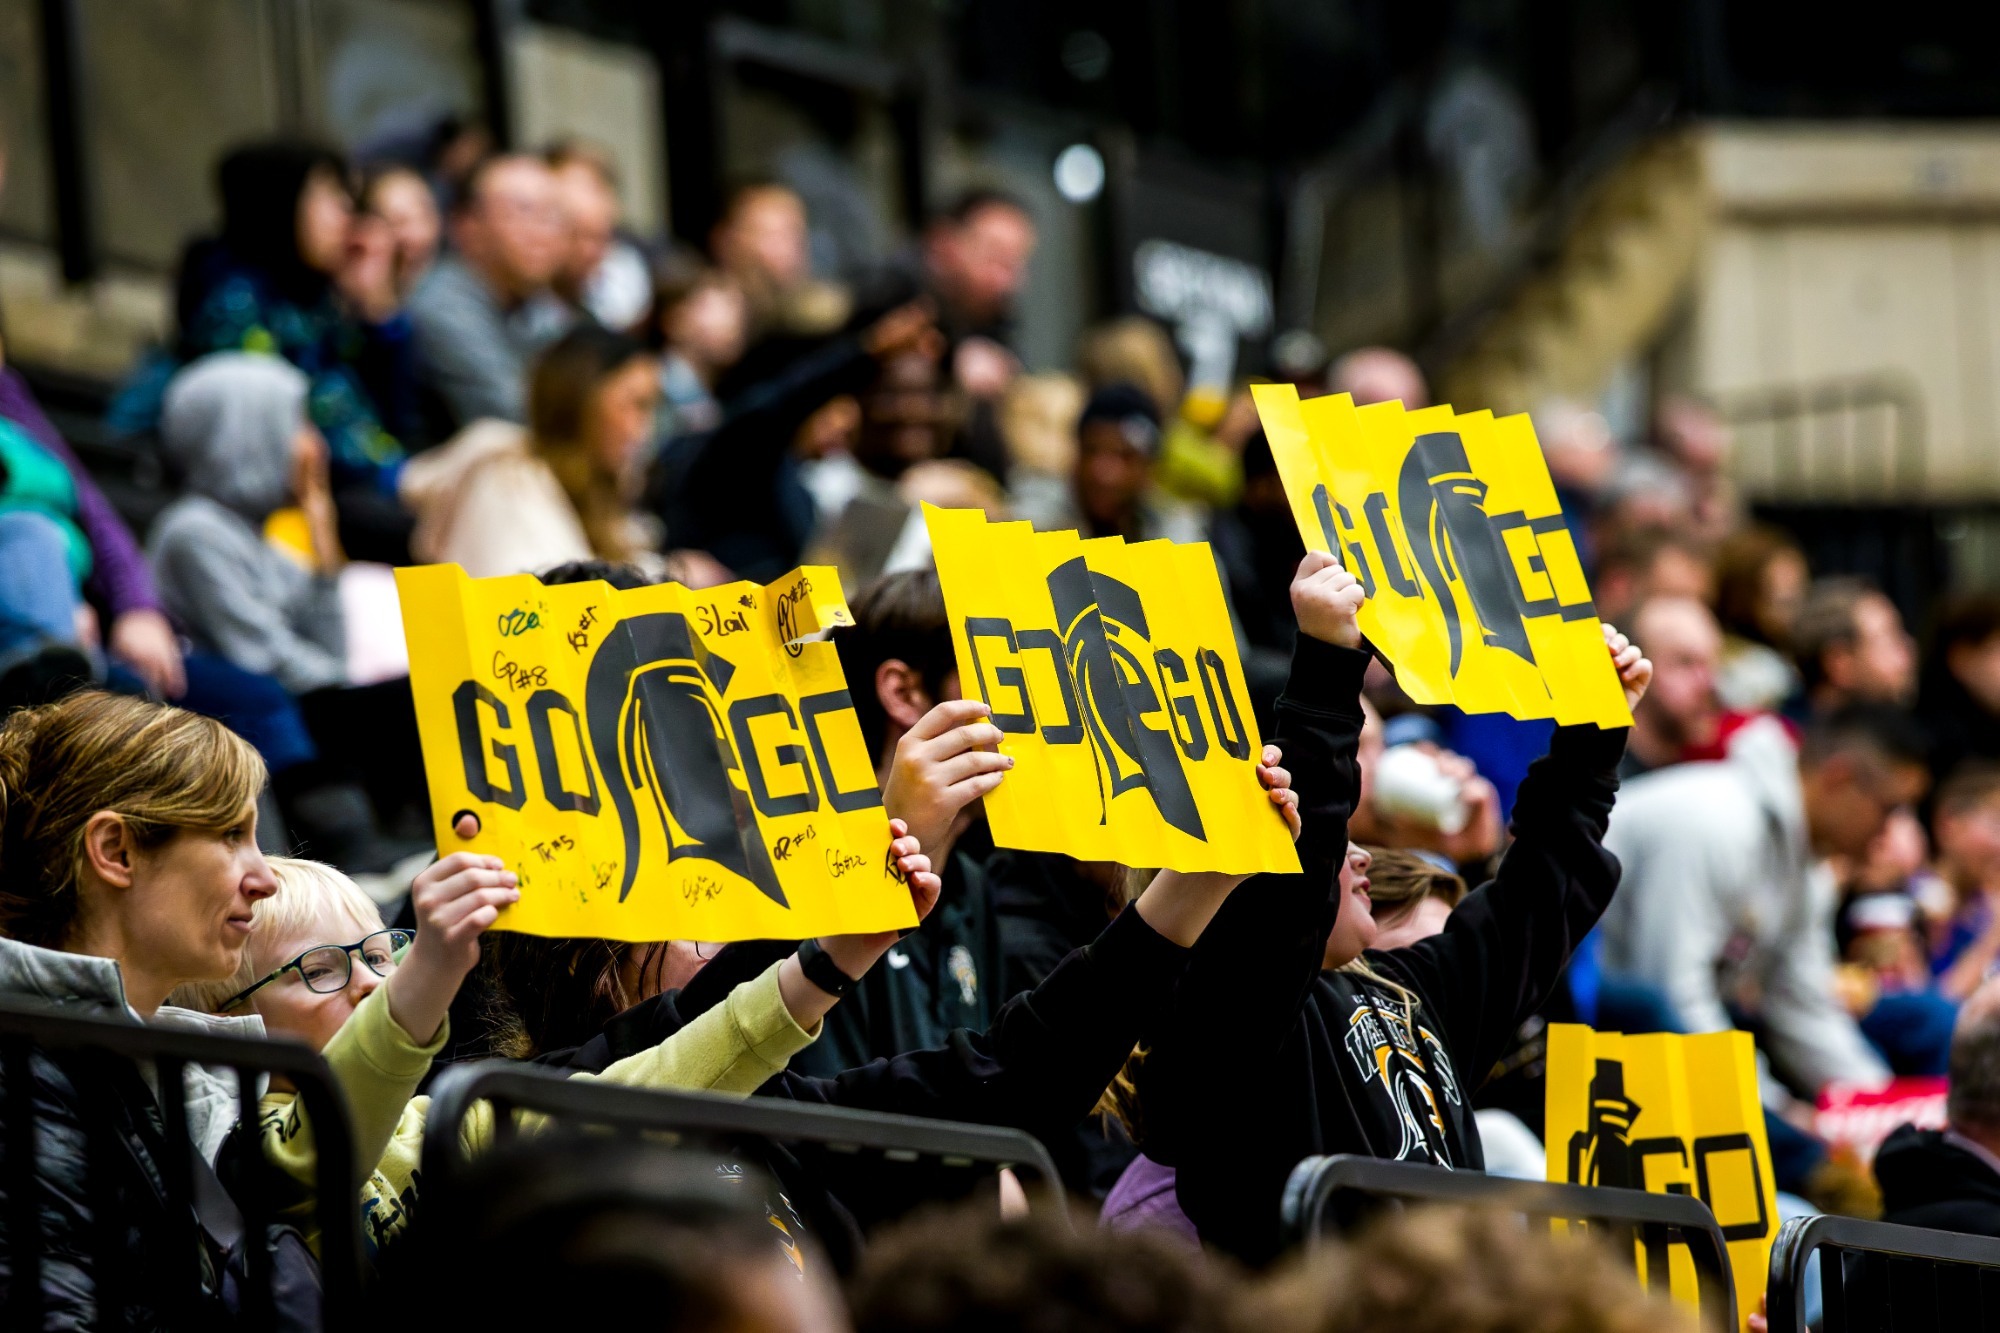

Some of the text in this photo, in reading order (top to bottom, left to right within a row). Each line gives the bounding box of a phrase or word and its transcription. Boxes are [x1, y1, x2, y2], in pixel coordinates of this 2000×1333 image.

[452, 680, 602, 818] GO
[965, 616, 1251, 762] GO GO
[1629, 1133, 1769, 1242] GO
